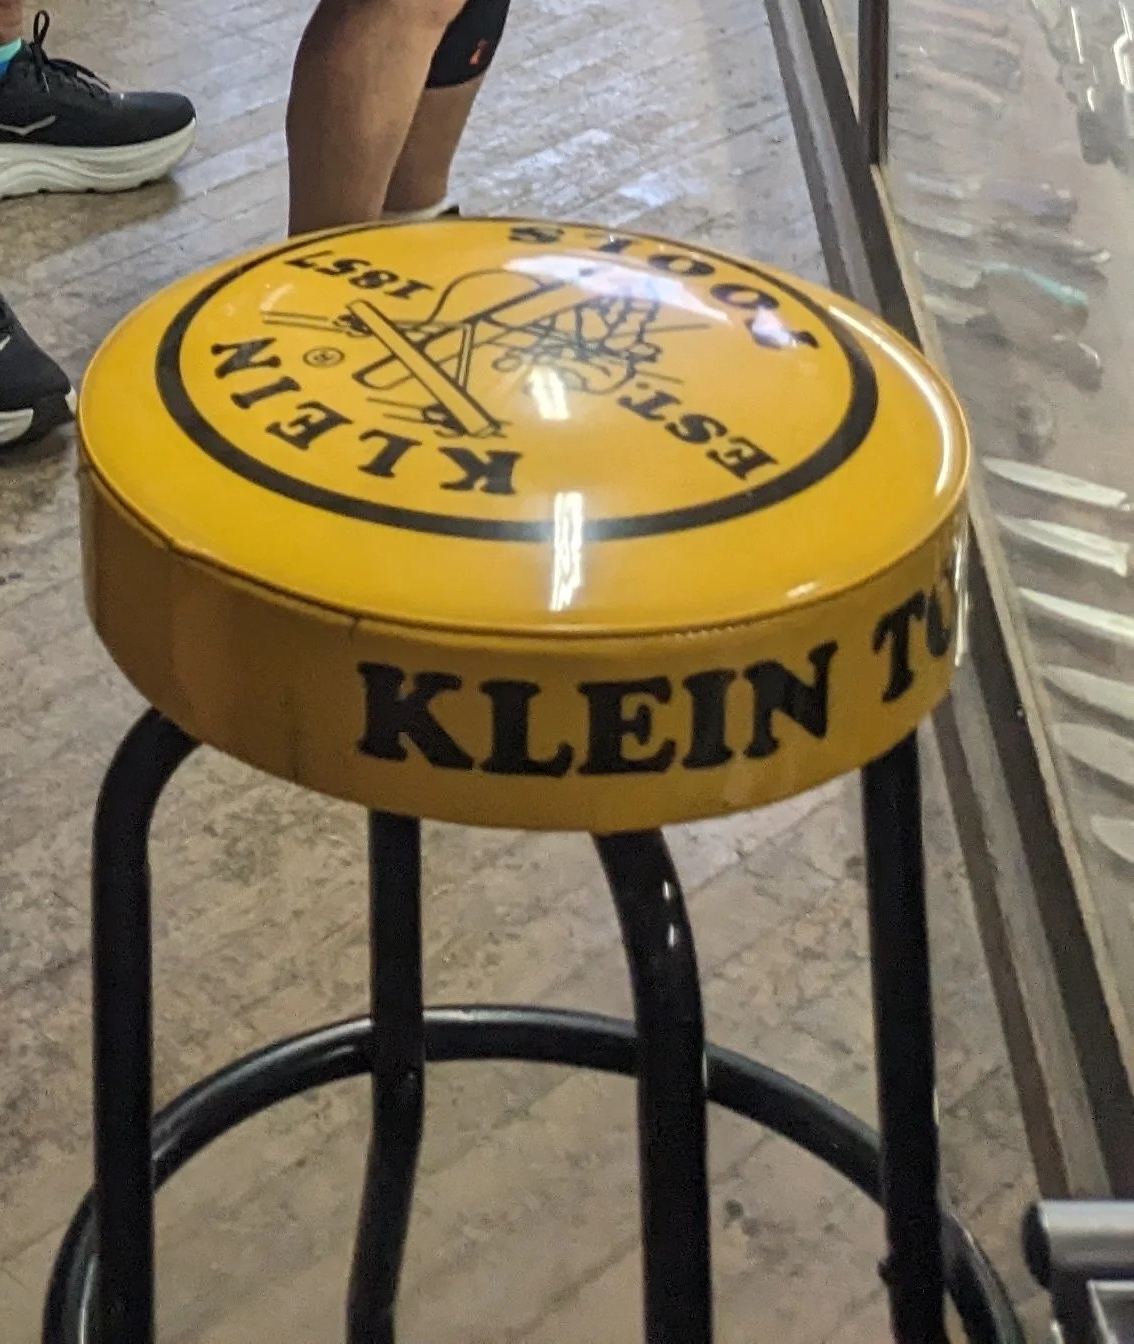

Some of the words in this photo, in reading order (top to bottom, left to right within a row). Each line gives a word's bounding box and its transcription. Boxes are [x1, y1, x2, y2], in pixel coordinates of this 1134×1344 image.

[283, 249, 435, 300] 1857
[210, 336, 523, 496] KLEIN
[617, 381, 780, 481] EST.
[357, 640, 839, 778] KLEIN
